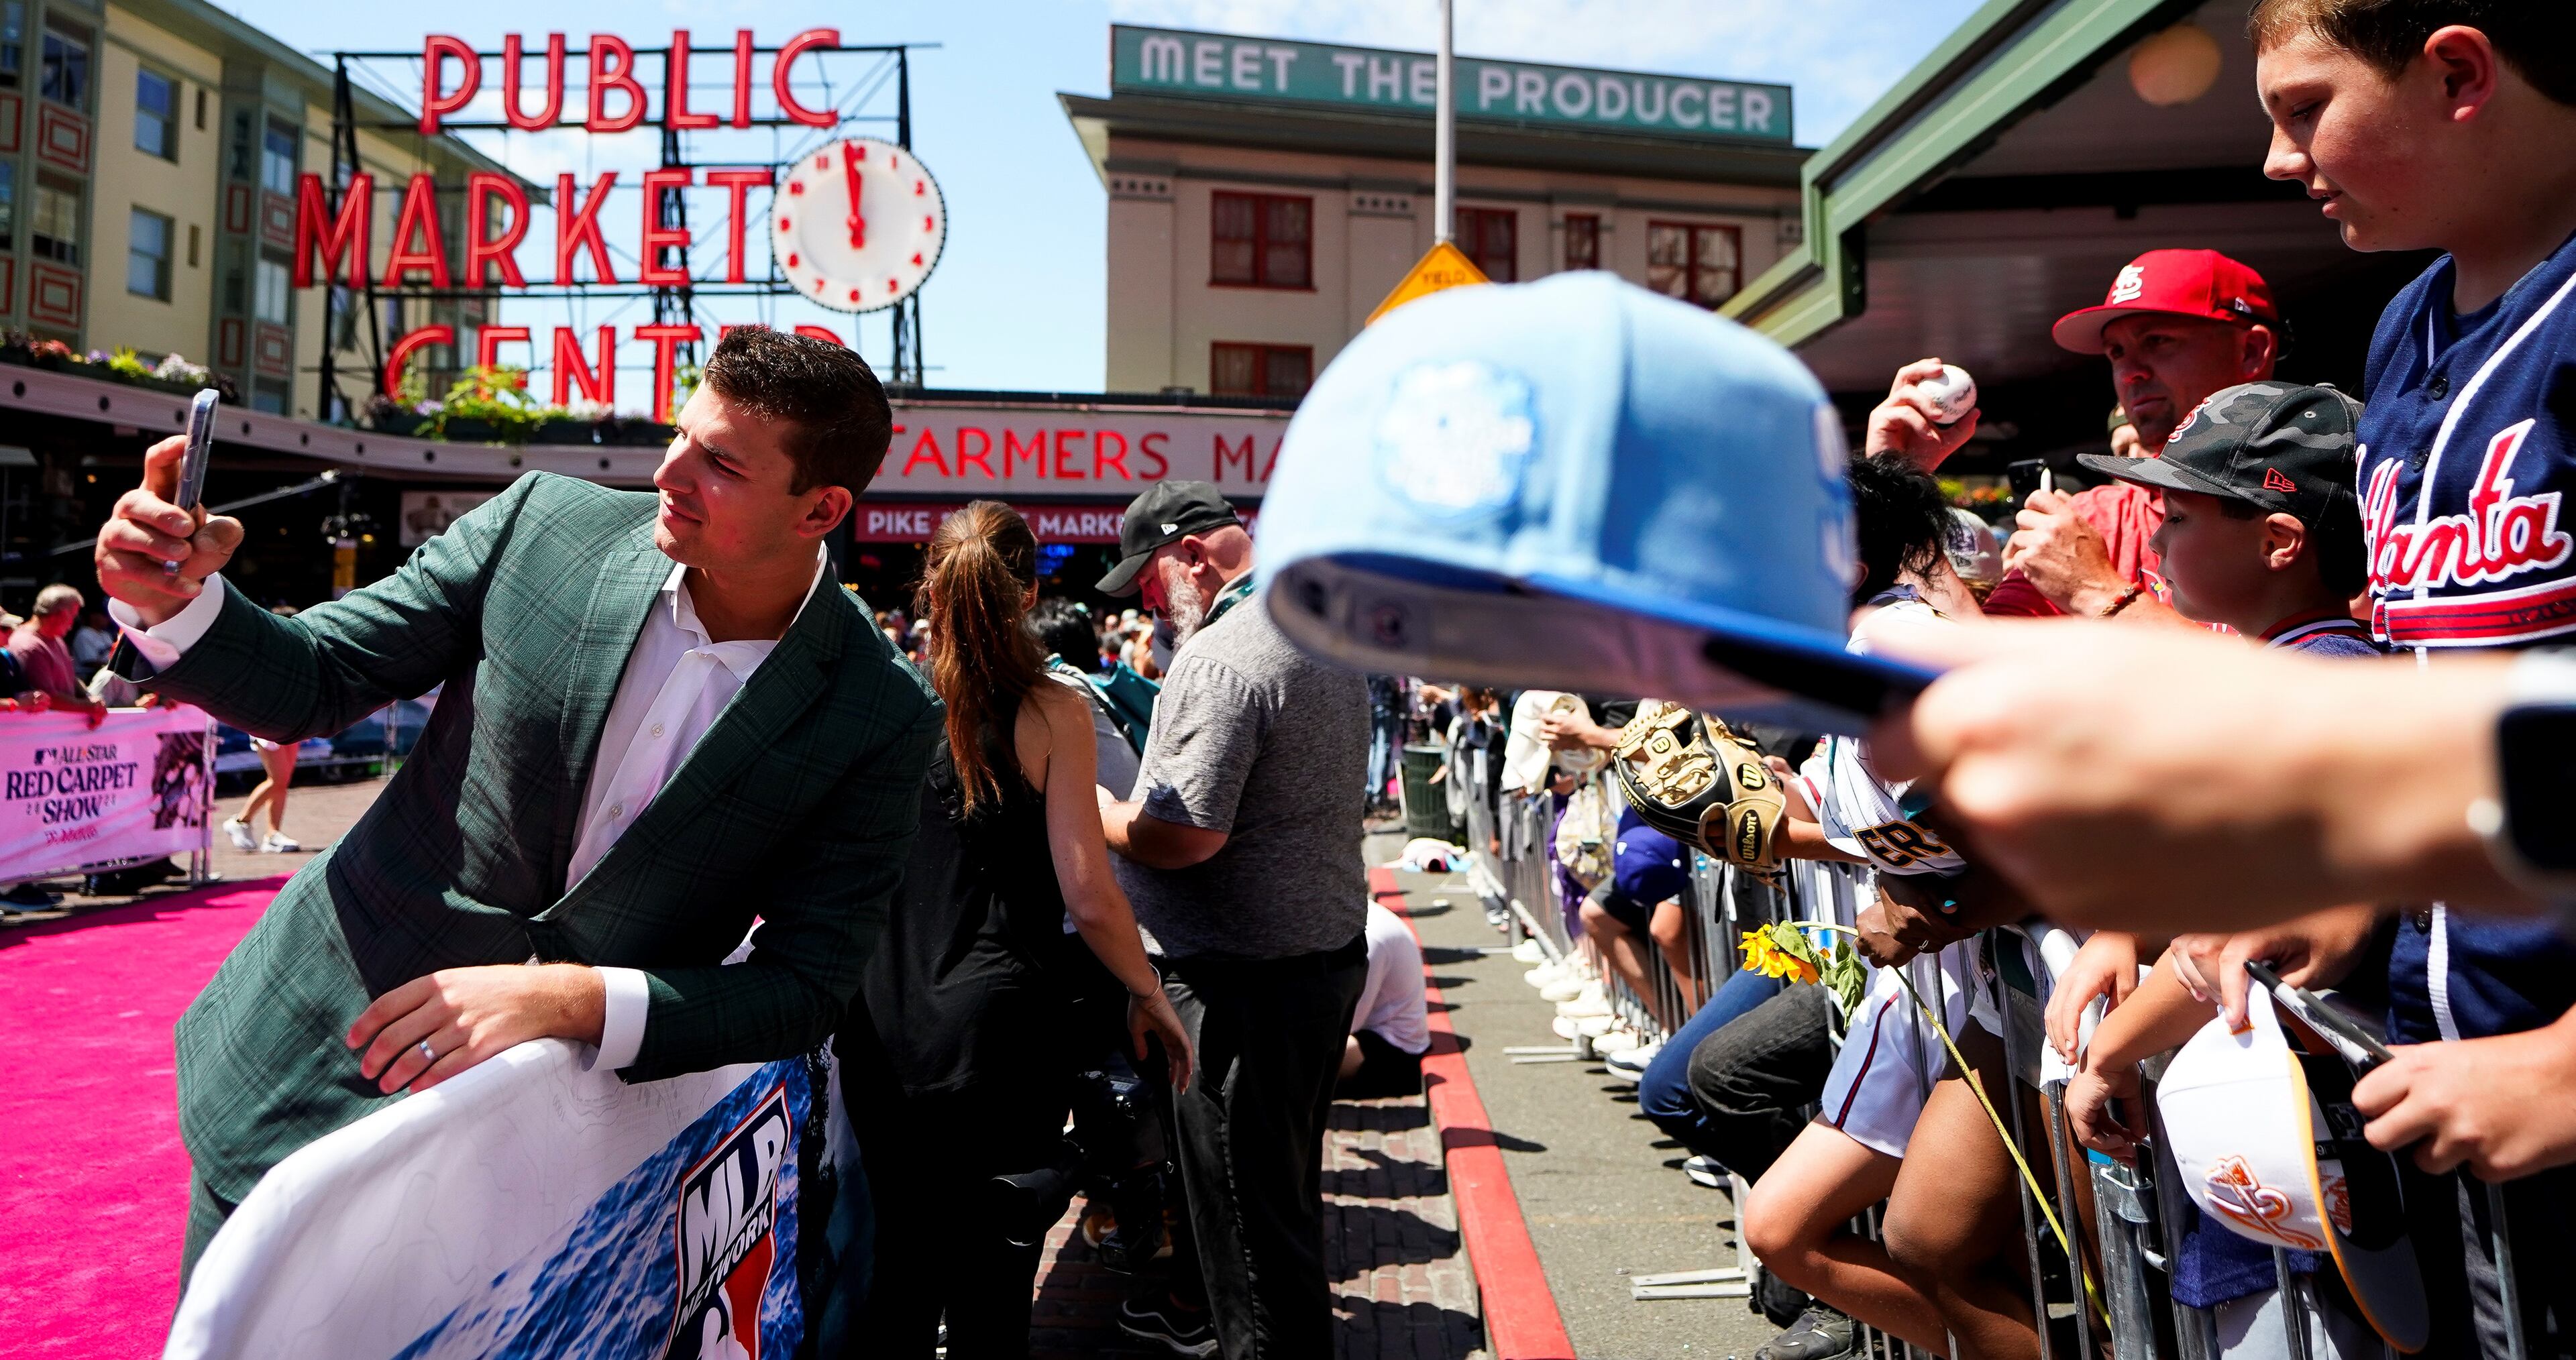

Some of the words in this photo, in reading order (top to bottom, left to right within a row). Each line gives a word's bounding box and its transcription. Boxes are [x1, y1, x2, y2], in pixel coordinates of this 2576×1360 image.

[419, 28, 841, 135] PUBLIC
[1140, 36, 1299, 92] MEET
[1333, 54, 1437, 105] THE
[1479, 66, 1773, 132] PRODUCER
[292, 168, 773, 290] MARKET
[384, 323, 847, 424] CENT
[867, 511, 931, 534] PIKE
[7, 771, 54, 800] RED
[57, 762, 138, 795] CARPET
[43, 796, 103, 825] SHOW
[1742, 815, 1757, 860] Wilson
[1852, 819, 1951, 869] ER
[686, 1115, 786, 1300] MLB
[675, 1201, 770, 1338] NETWORK
